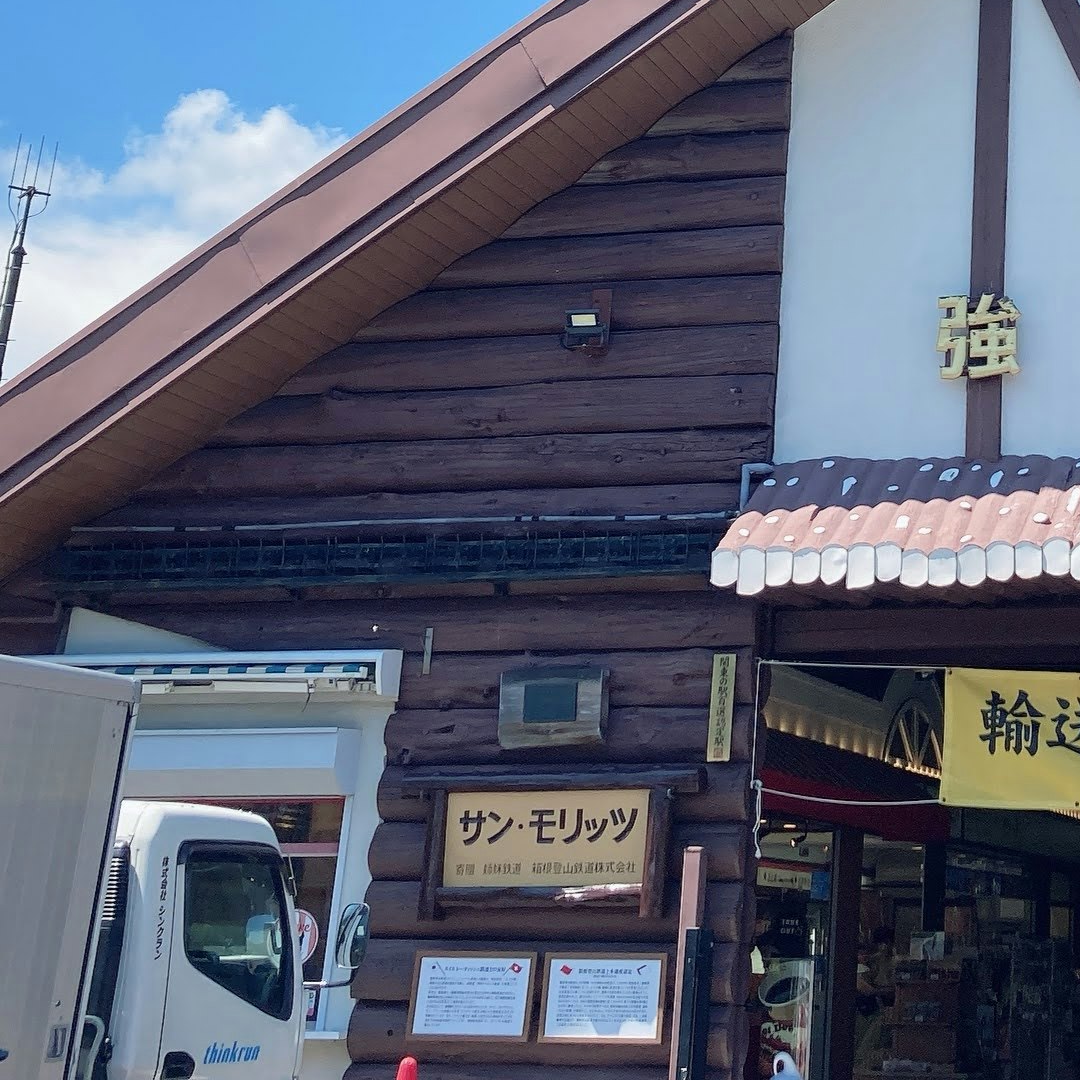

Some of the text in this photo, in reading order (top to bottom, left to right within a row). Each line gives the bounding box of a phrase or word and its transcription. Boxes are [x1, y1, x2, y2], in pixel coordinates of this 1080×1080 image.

[459, 807, 639, 846] サン・モリッツ
[203, 1041, 260, 1064] thinkrun
